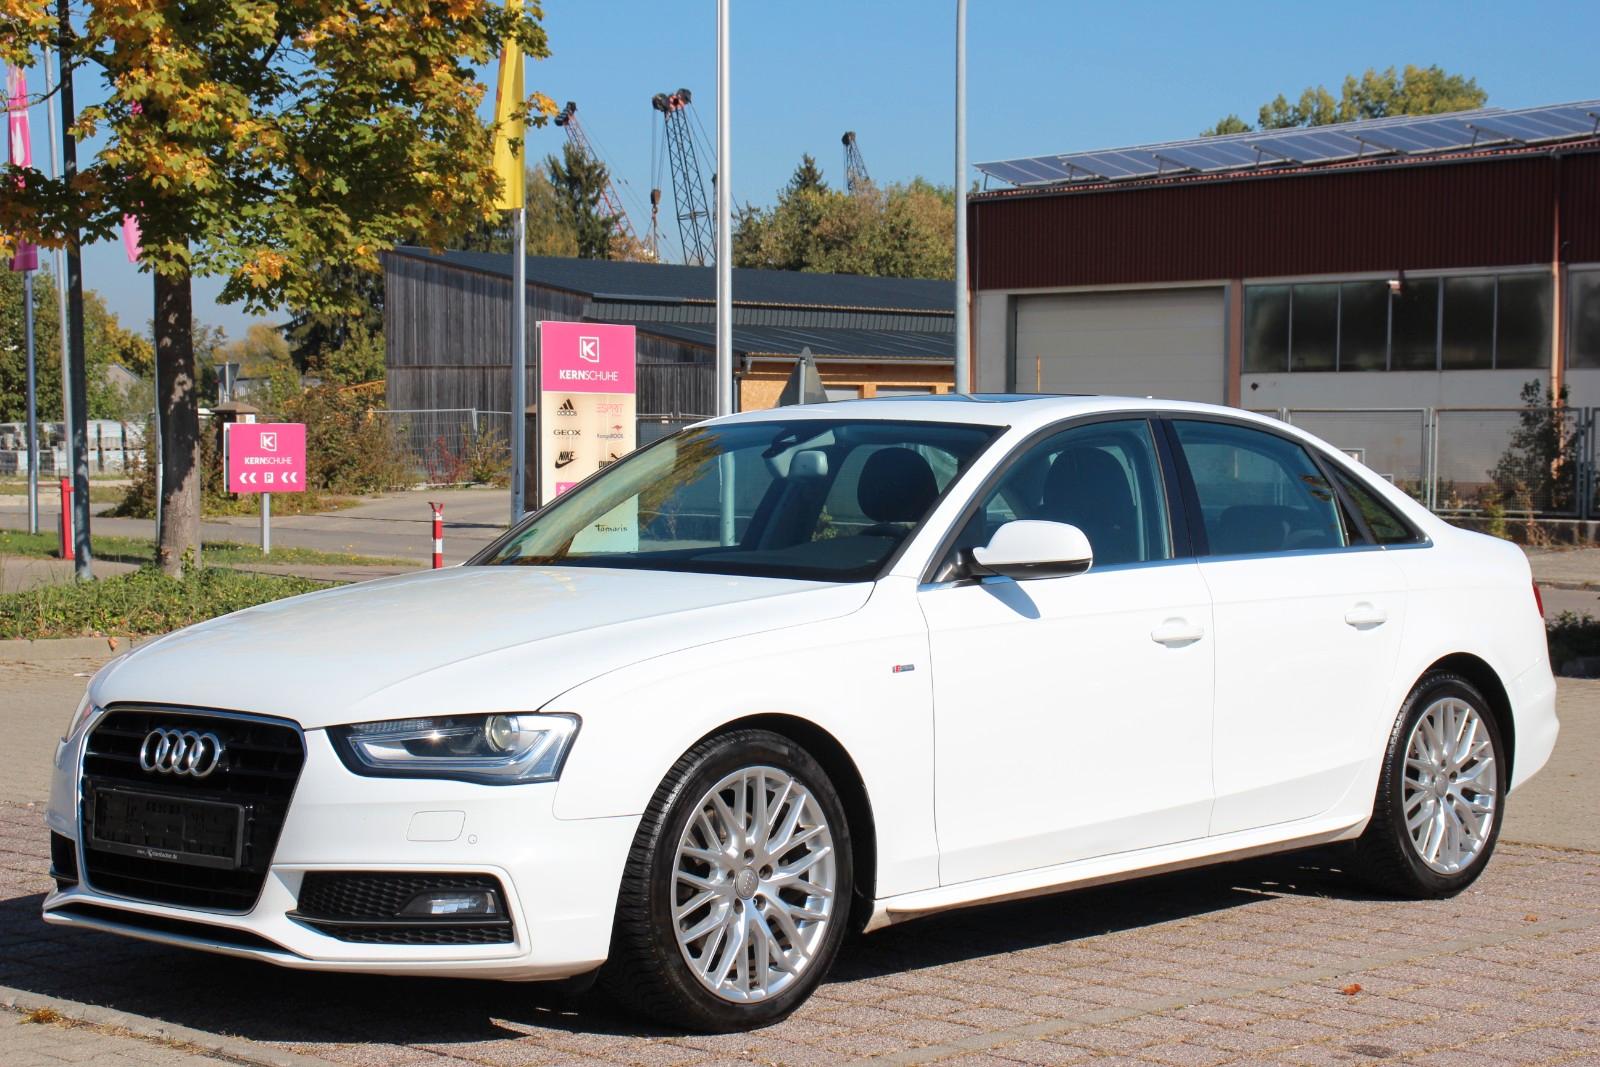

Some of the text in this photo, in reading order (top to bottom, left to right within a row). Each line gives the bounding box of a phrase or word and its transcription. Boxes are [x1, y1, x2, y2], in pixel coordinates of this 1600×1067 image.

[559, 369, 619, 381] KERNSCHUHE
[244, 456, 292, 465] KERNSCHUHE
[559, 451, 575, 461] NIKE
